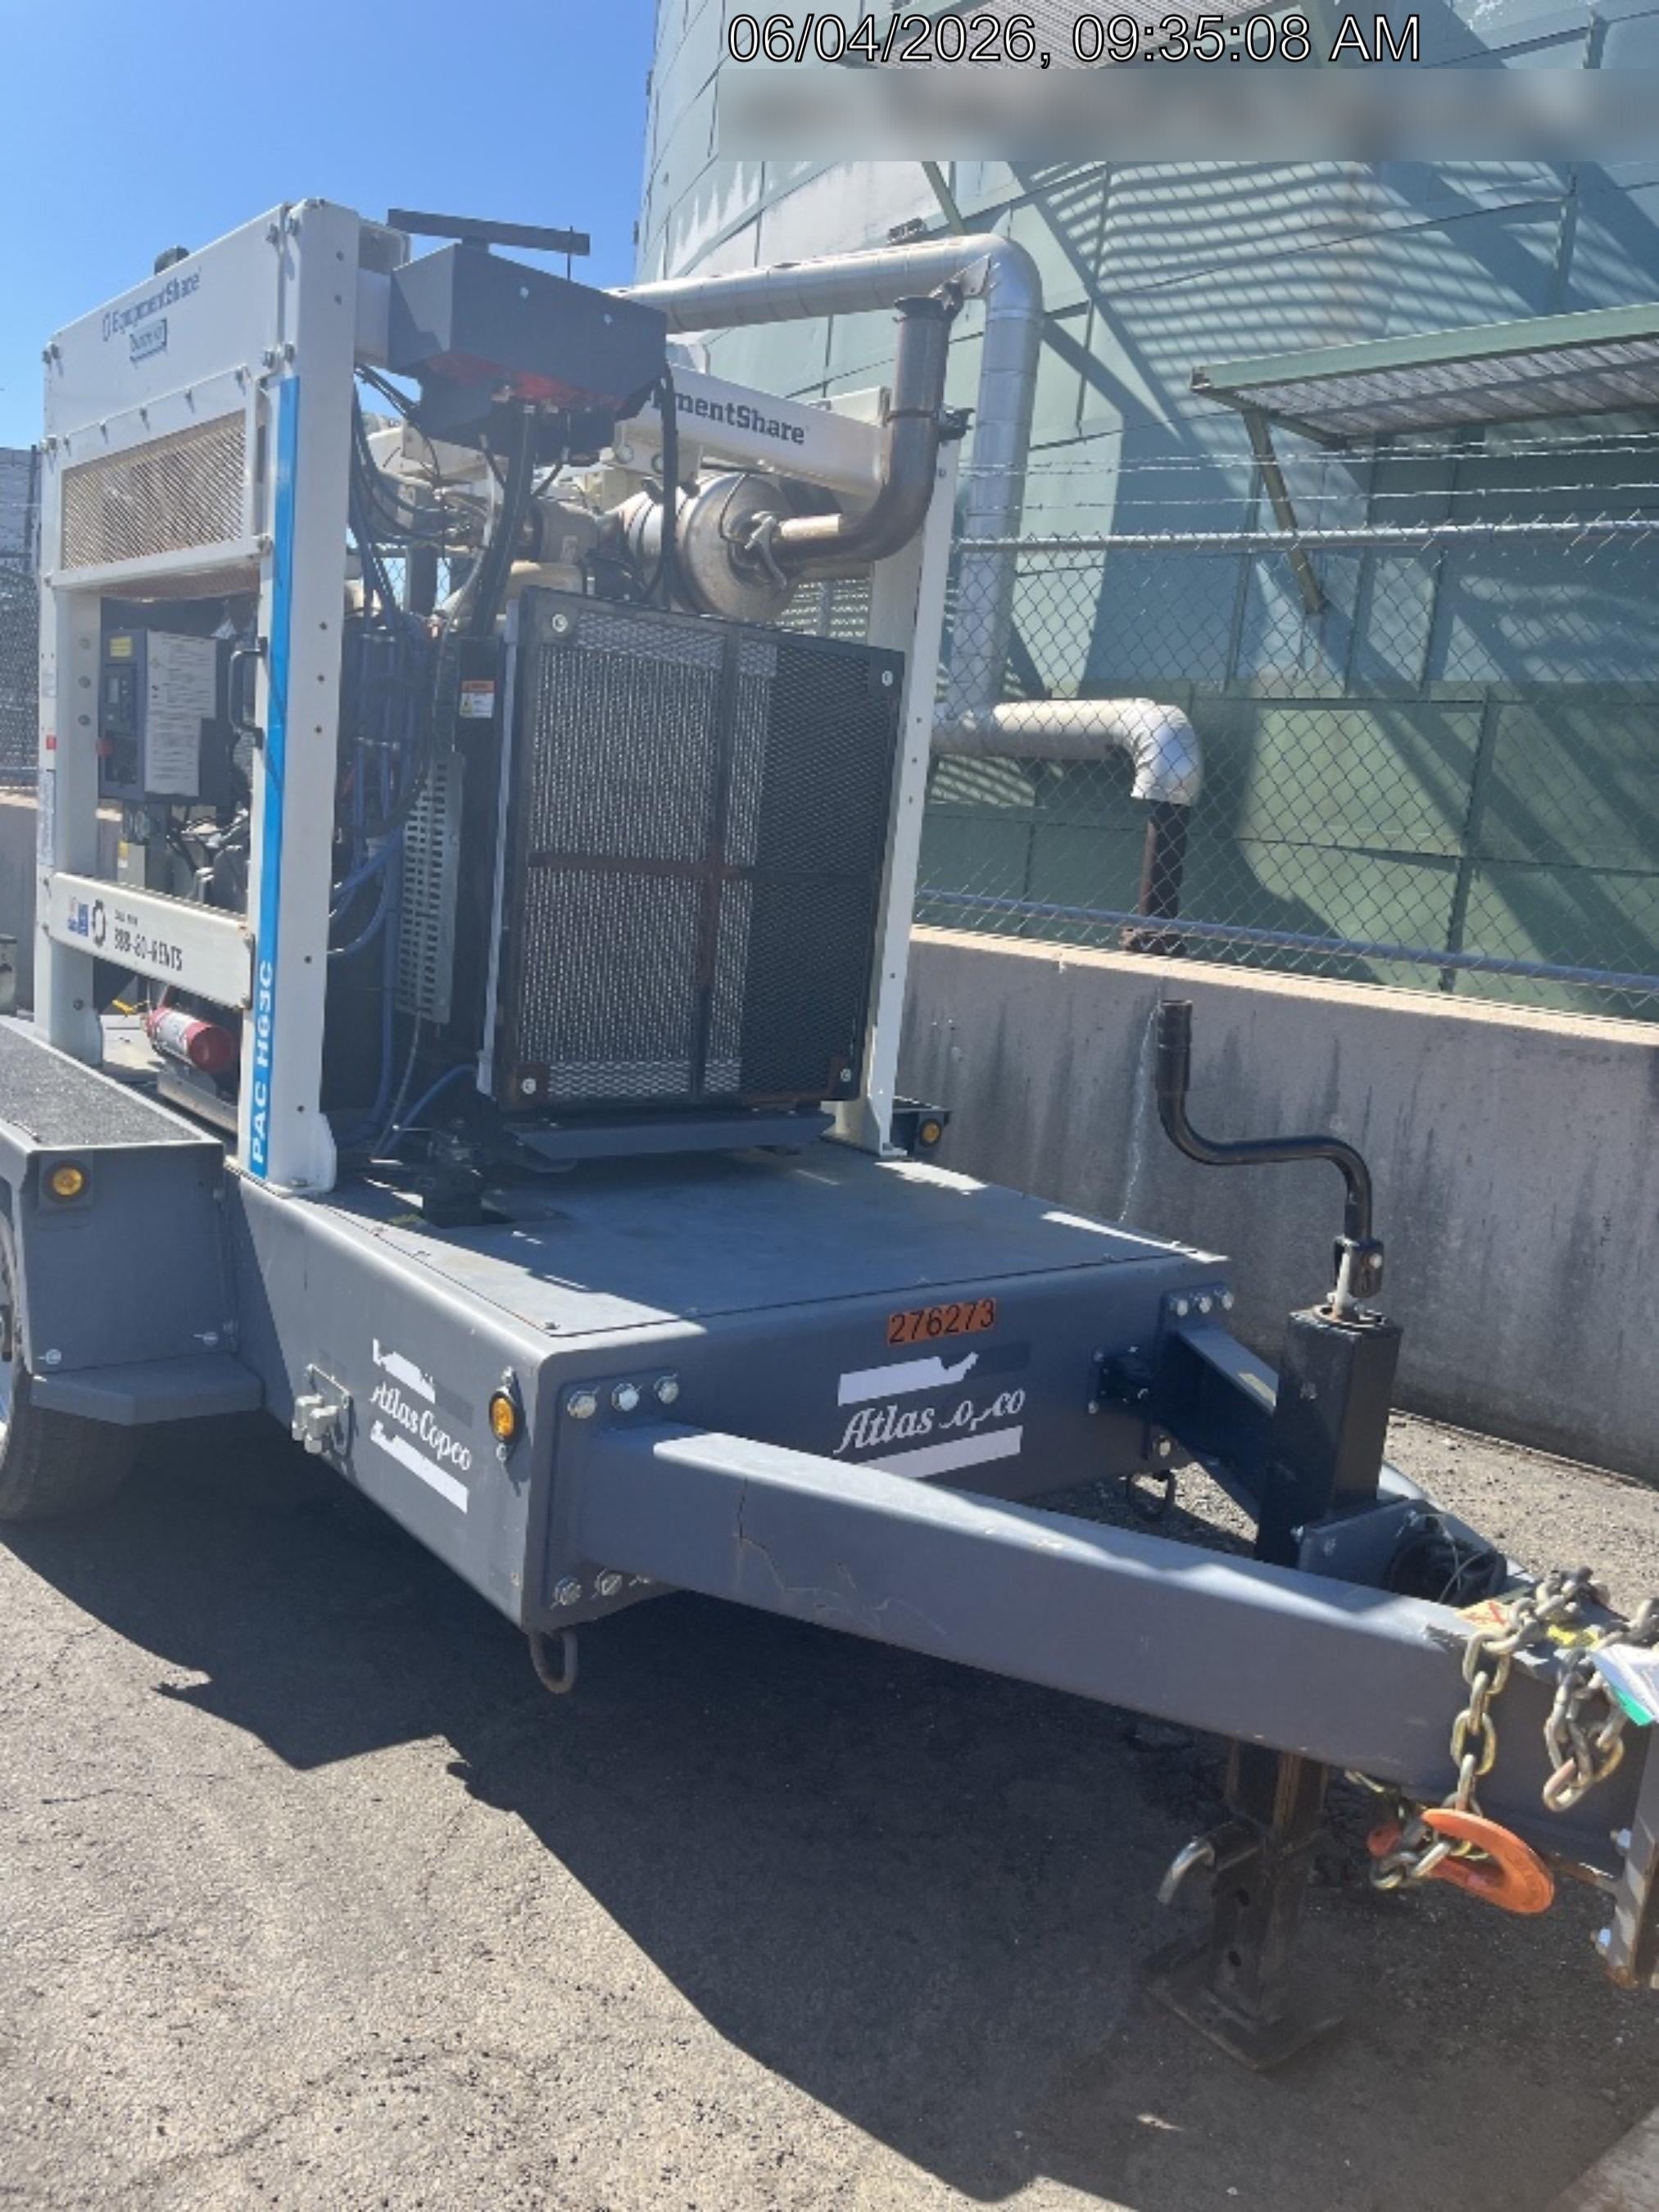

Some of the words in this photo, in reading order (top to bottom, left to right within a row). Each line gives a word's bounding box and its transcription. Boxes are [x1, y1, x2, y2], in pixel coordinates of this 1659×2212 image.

[252, 1081, 267, 1164] PAC
[889, 1299, 995, 1344] 276273
[419, 1409, 473, 1471] Copco
[832, 1403, 936, 1455] Atlas
[939, 1388, 1026, 1432] oco
